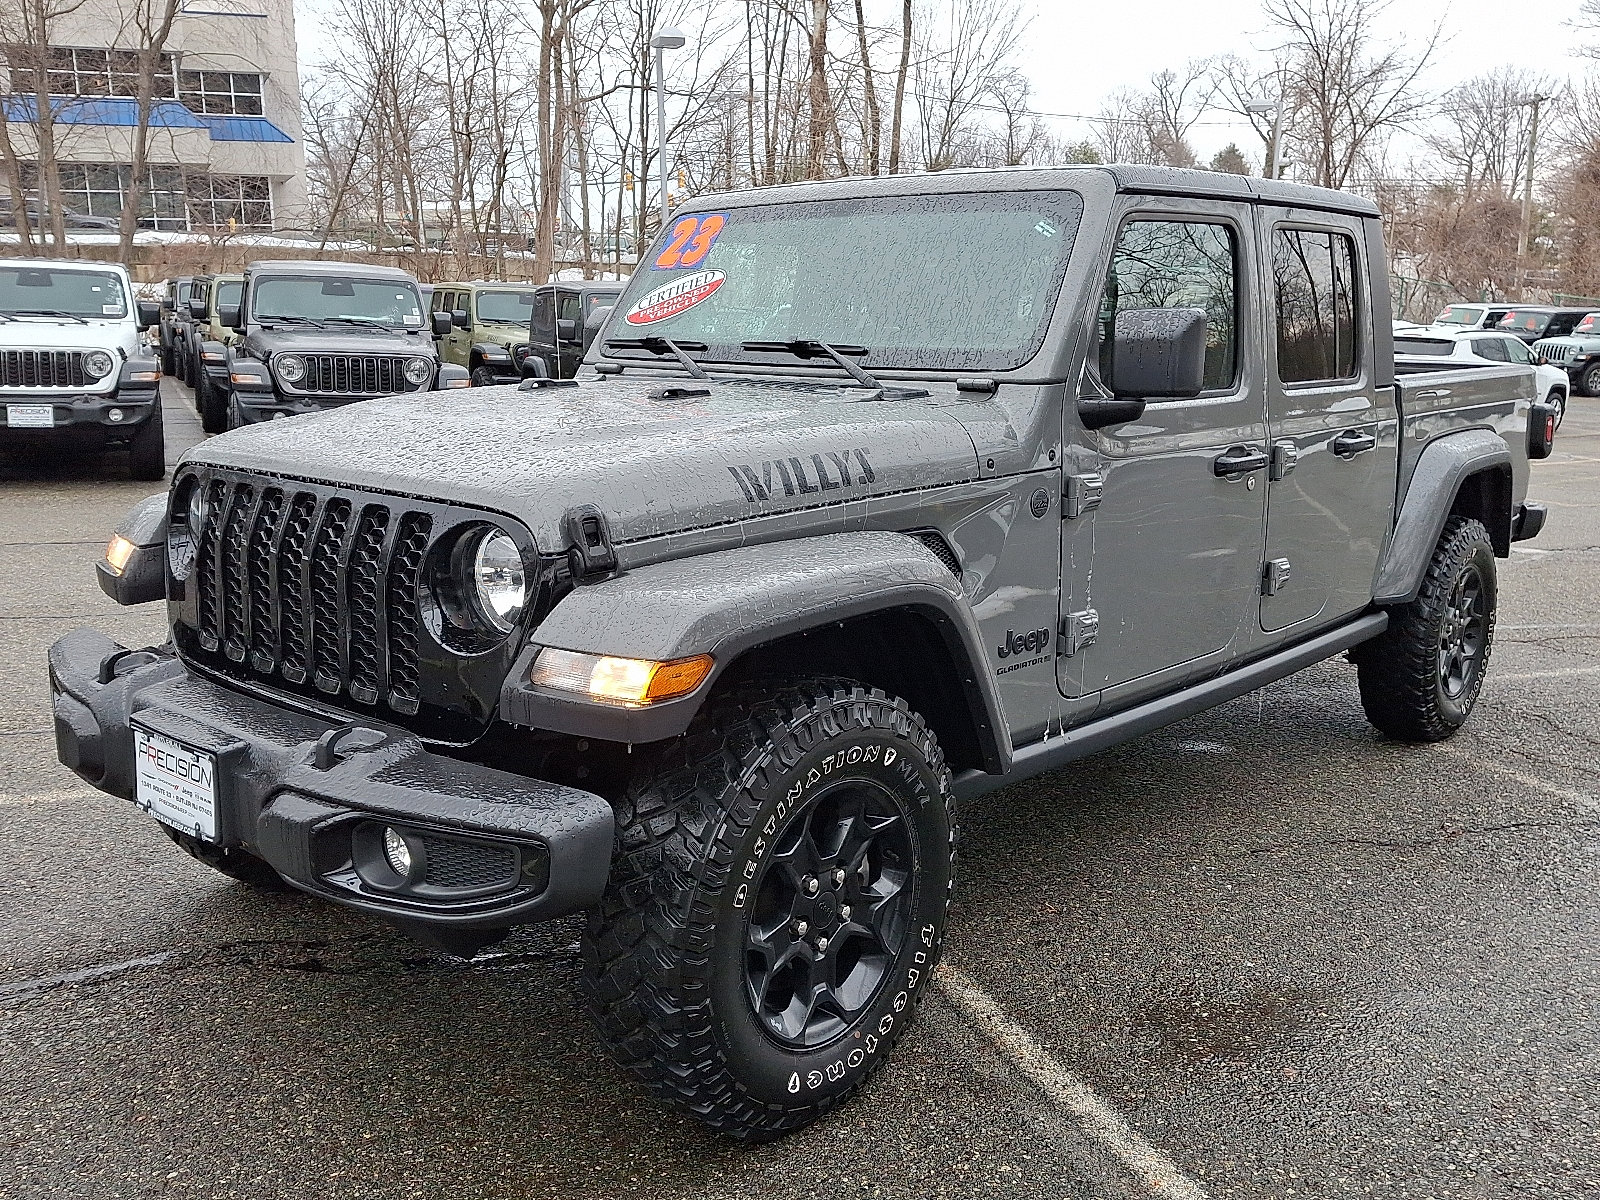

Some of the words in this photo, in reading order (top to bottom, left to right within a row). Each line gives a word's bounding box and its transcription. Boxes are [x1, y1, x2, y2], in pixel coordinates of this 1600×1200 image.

[655, 214, 725, 268] 23
[638, 271, 716, 310] CERTIFIED
[639, 285, 709, 318] PRE-OWNED
[649, 295, 699, 319] VEHICLE
[727, 447, 875, 502] WILLYS
[997, 627, 1050, 658] Jeep
[996, 656, 1043, 676] GLADIATOR
[139, 741, 212, 789] PRECISION
[733, 745, 881, 908] DESTINATION
[806, 923, 935, 1090] Firestone
